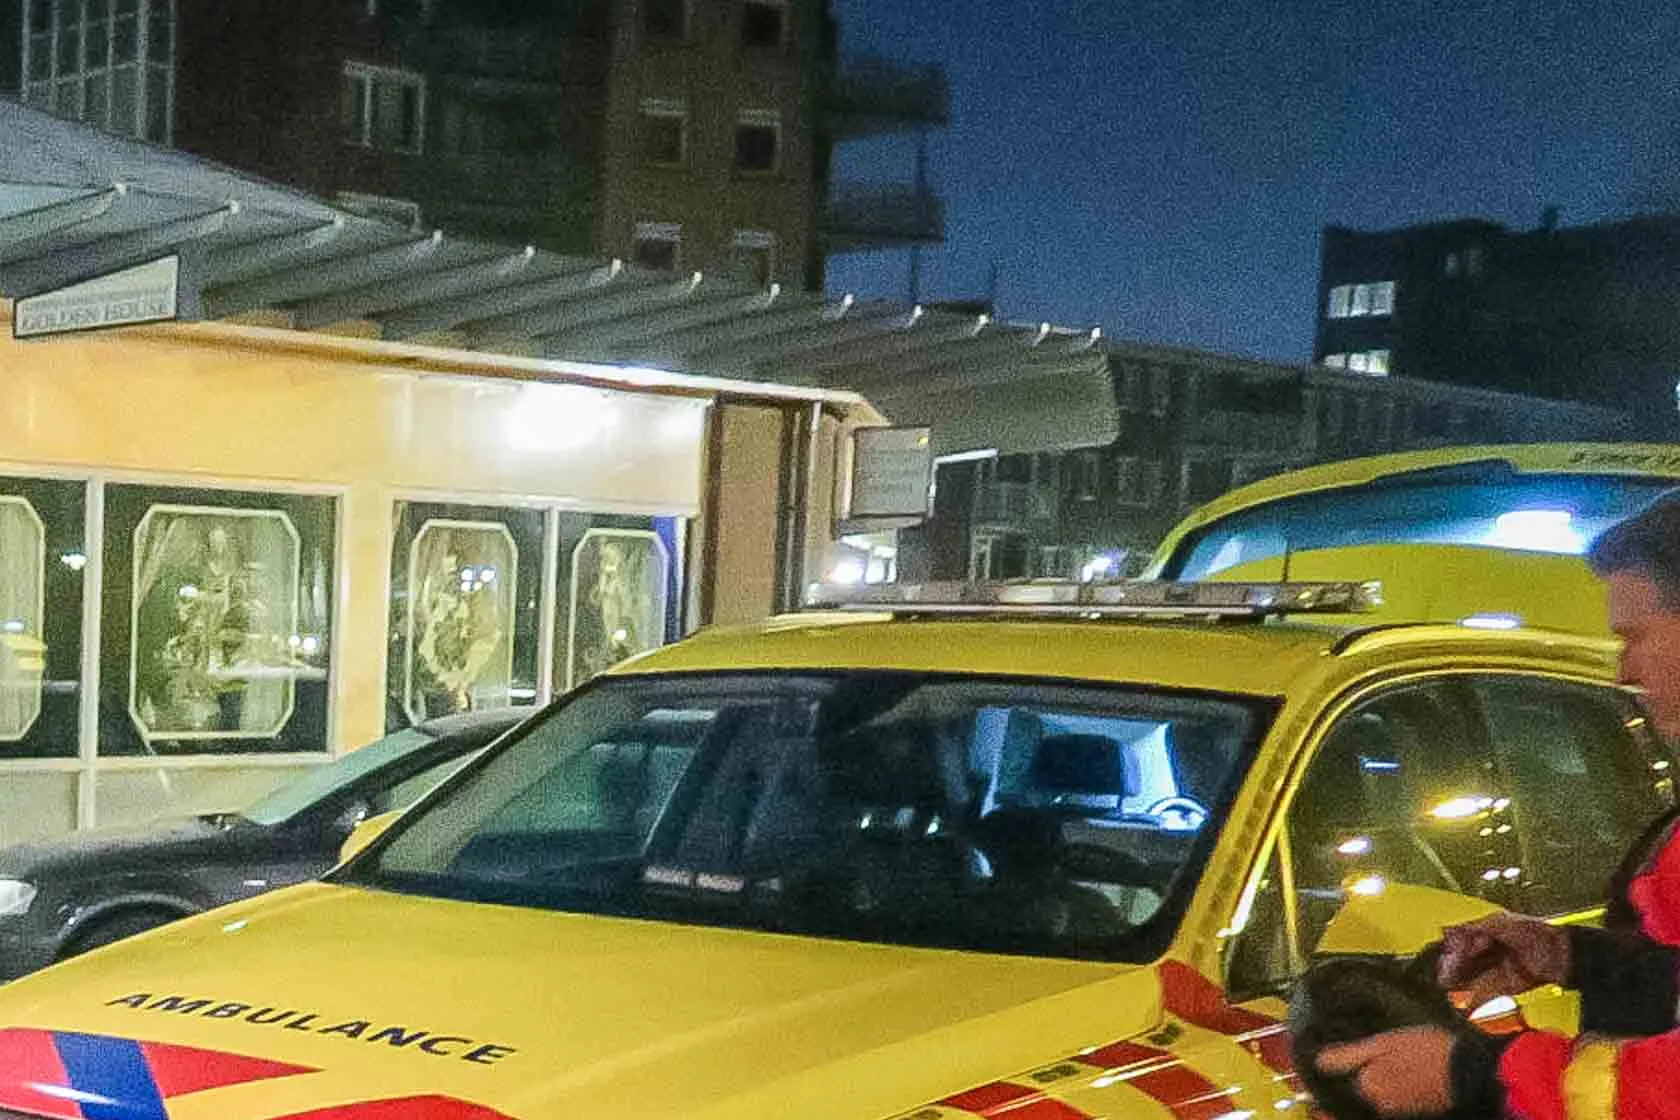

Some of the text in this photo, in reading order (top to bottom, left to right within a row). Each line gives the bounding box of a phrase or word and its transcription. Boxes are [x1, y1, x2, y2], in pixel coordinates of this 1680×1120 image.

[21, 301, 169, 331] GOLDEN HOUSE
[105, 992, 517, 1065] AMBULANCE
